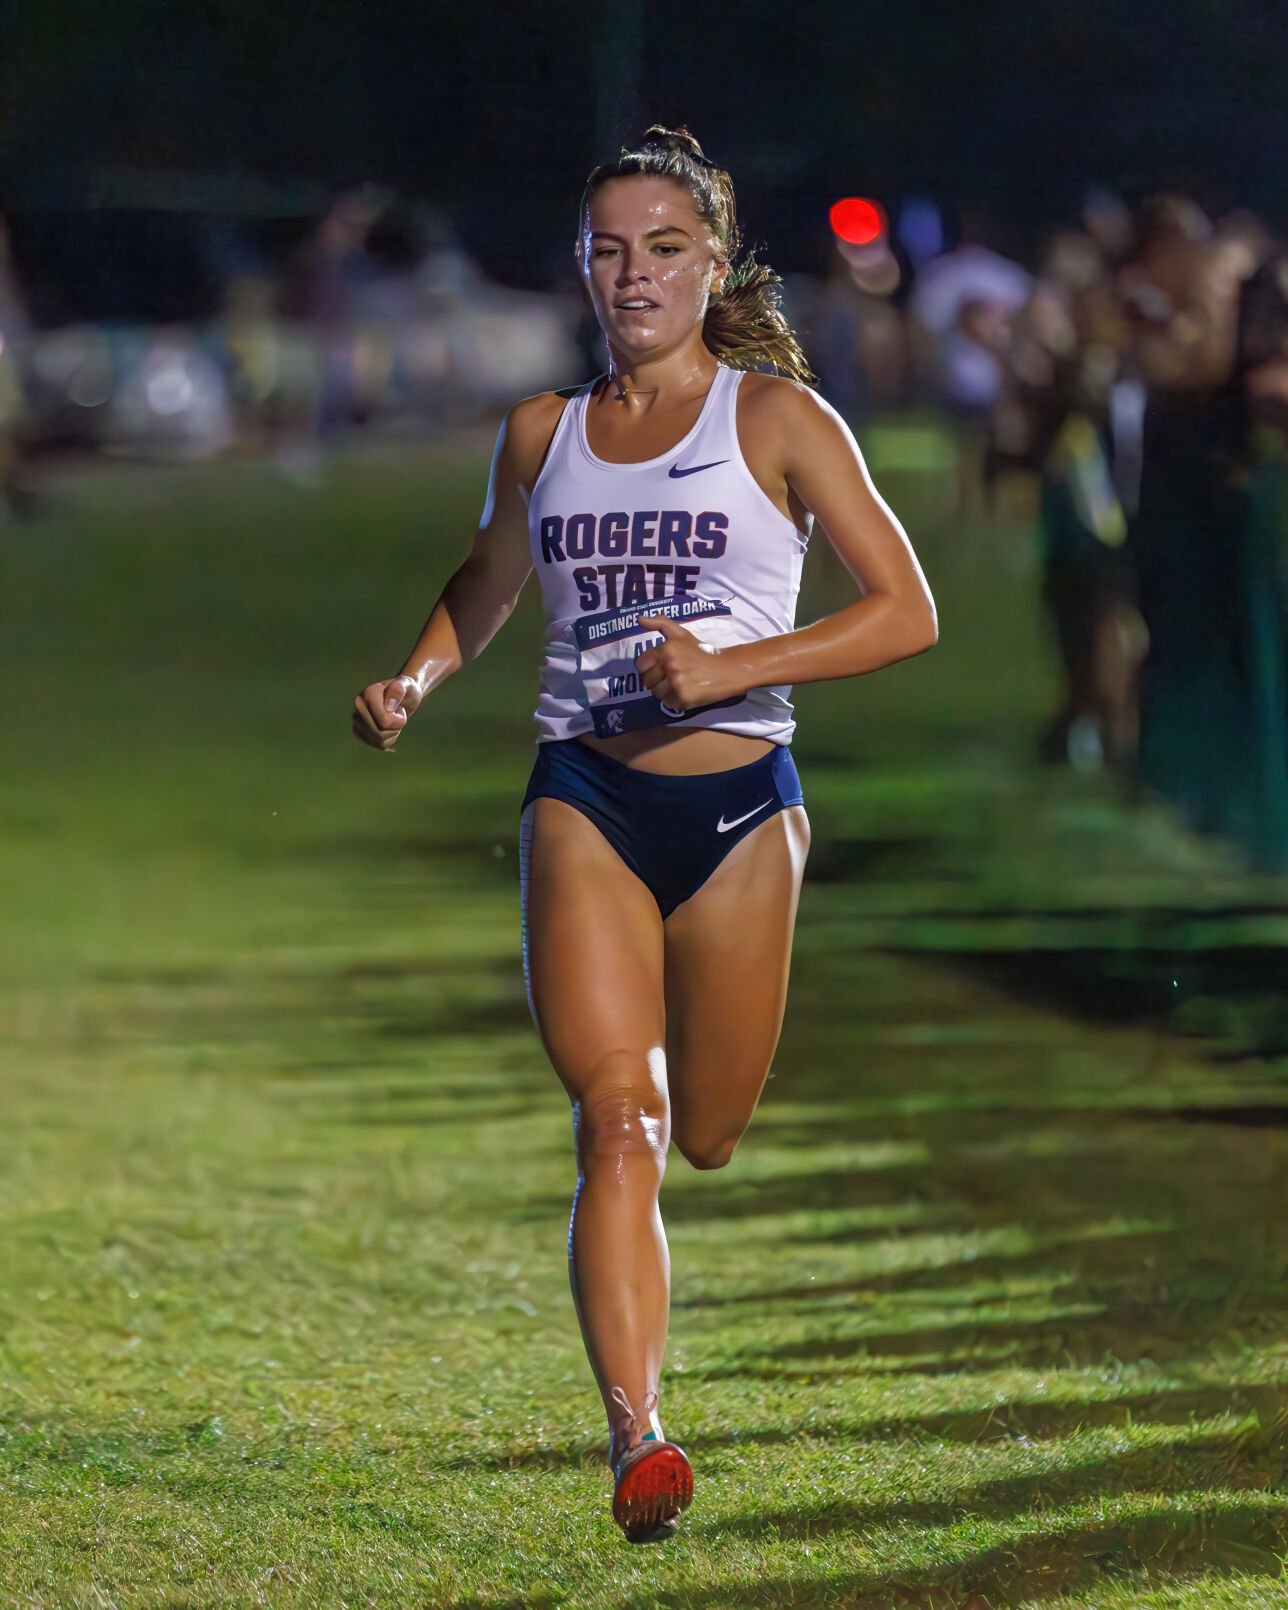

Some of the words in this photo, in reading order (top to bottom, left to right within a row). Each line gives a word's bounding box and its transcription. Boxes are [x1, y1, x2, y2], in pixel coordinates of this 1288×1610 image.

[541, 511, 729, 563] ROGERS
[573, 564, 701, 611] STATE
[588, 612, 639, 640] DISTANCE
[643, 605, 679, 618] AFTER
[682, 601, 716, 616] DARK
